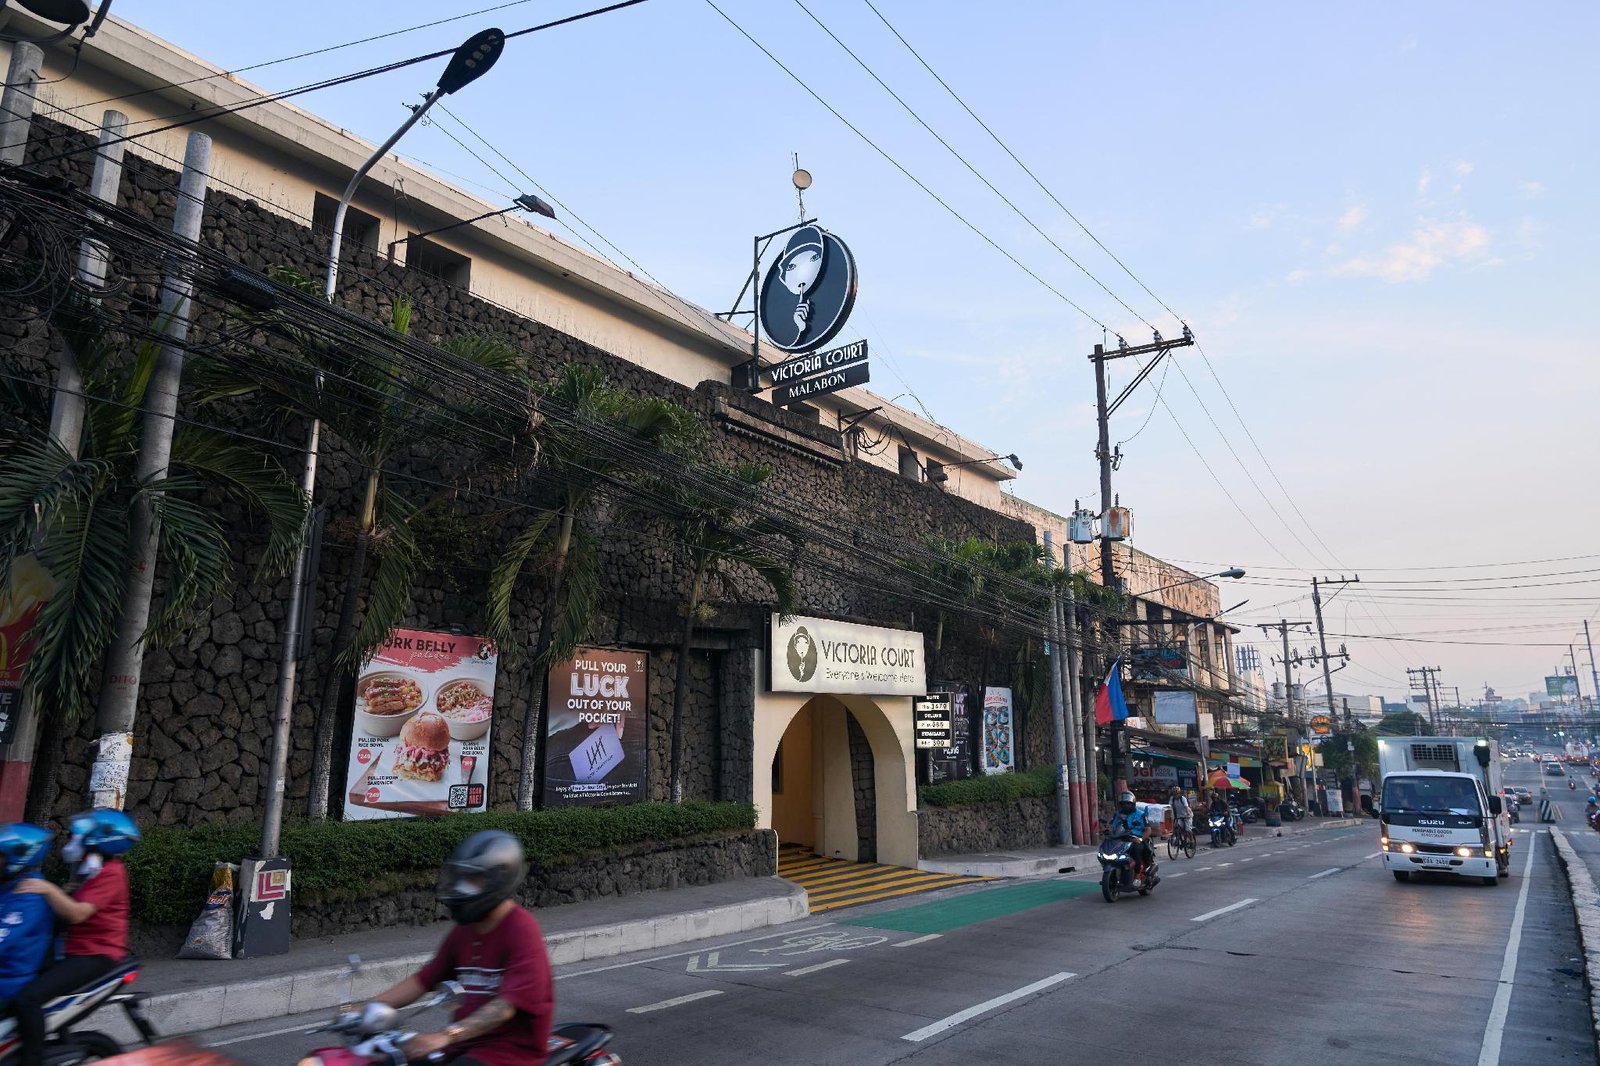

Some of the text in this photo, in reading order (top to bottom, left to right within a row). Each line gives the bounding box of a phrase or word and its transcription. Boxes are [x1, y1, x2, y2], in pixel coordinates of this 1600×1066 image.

[771, 341, 864, 382] VICTORIA COURT
[788, 372, 846, 398] MALABON
[382, 636, 457, 653] ORK BELLY
[821, 639, 915, 668] VICTORIA COURT
[575, 659, 627, 674] PULL YOUR
[570, 672, 630, 698] LUCK
[567, 698, 632, 711] OUT OF YOUR
[578, 712, 621, 723] POCKET!
[469, 787, 482, 795] SCAN
